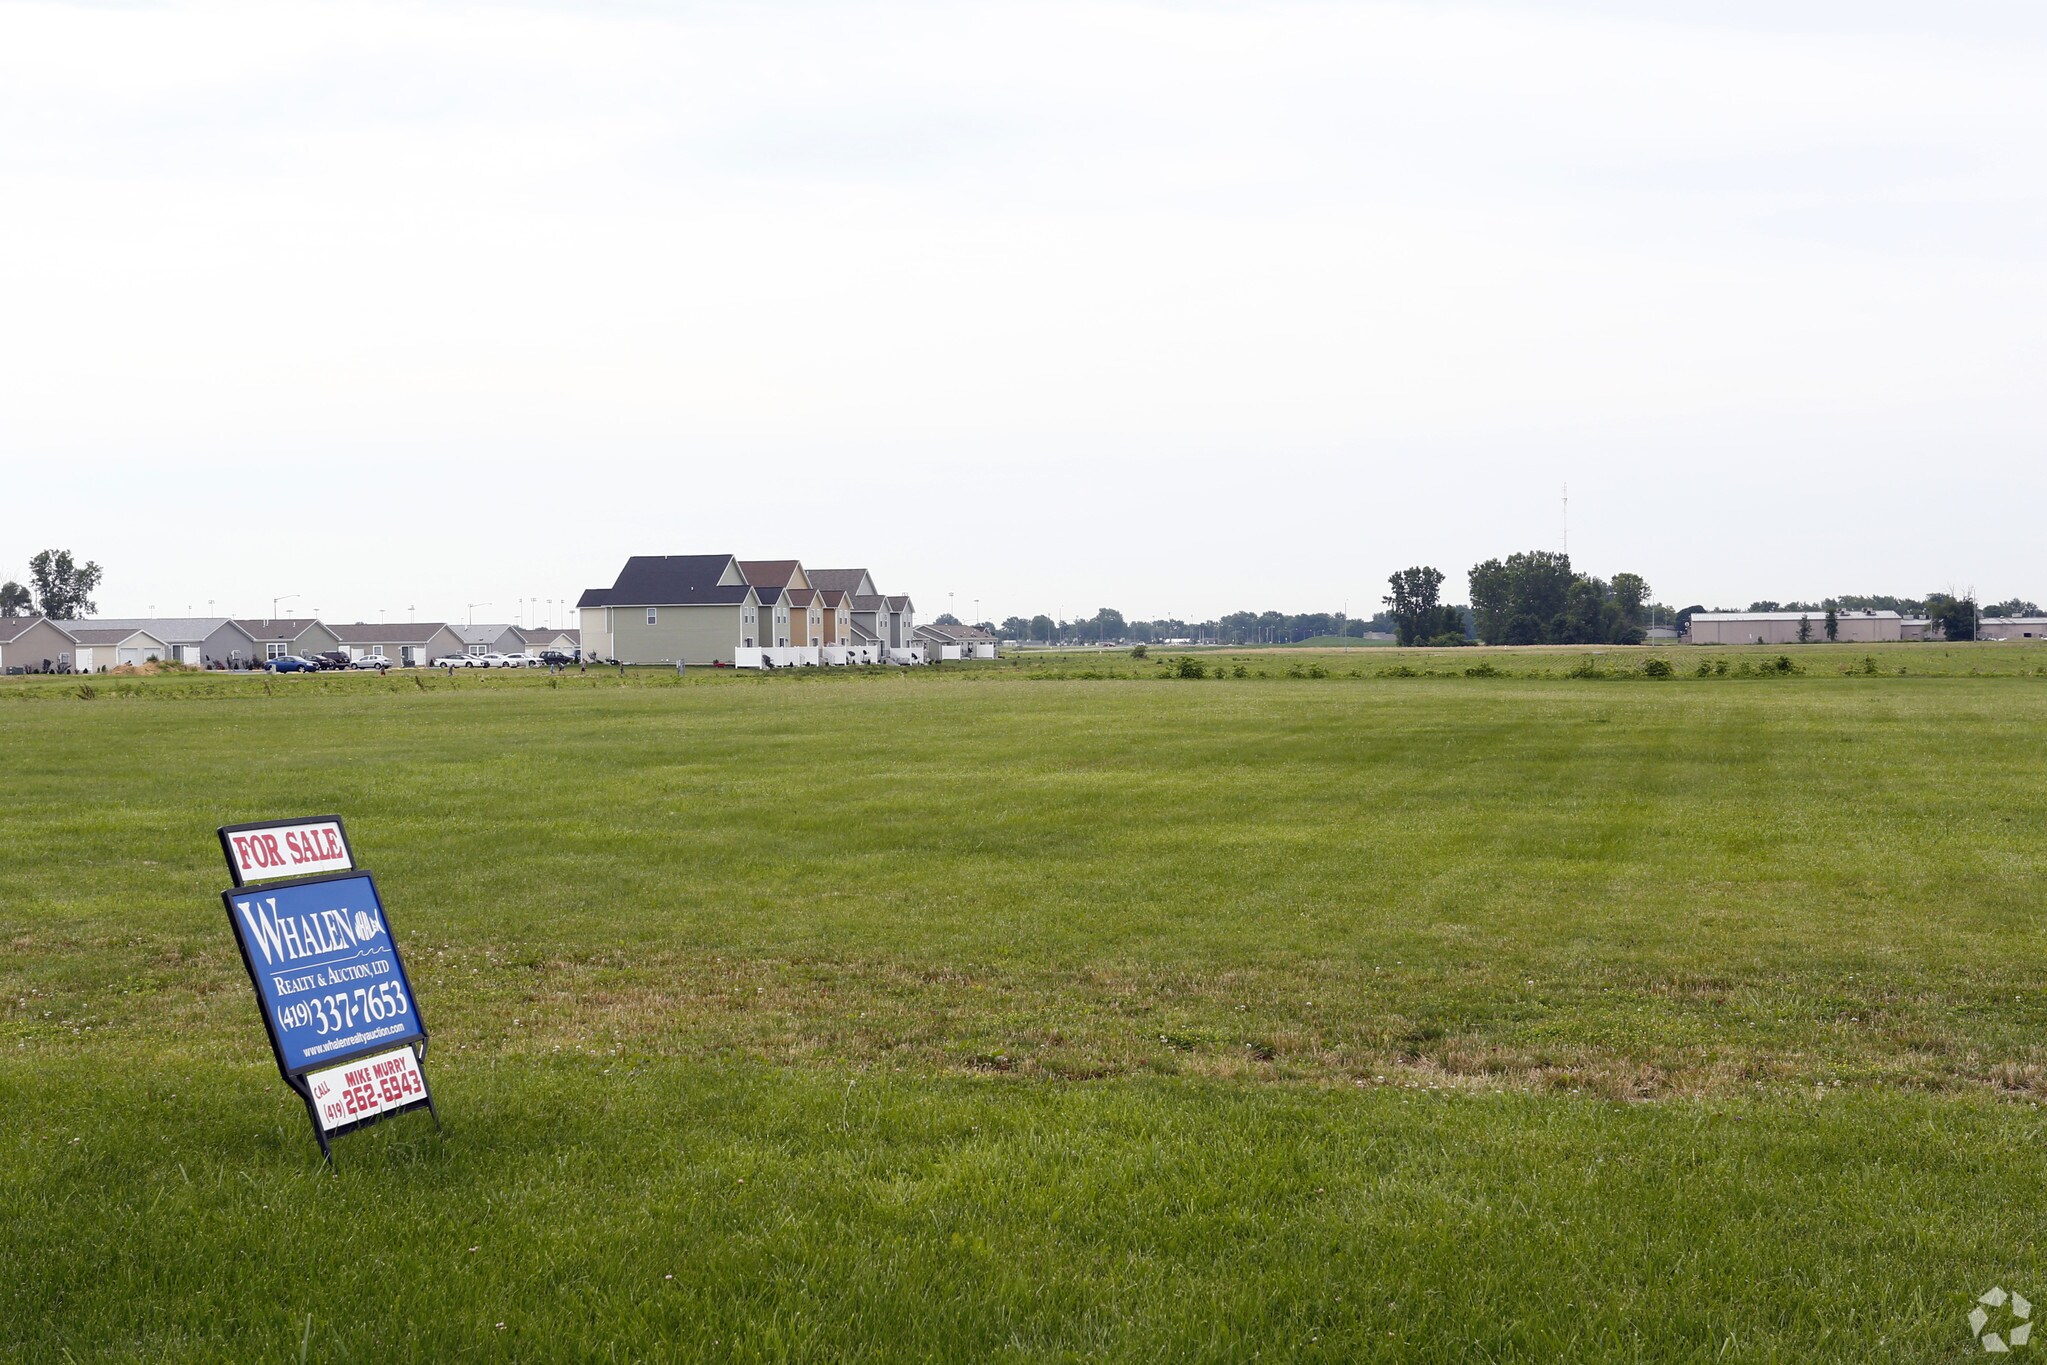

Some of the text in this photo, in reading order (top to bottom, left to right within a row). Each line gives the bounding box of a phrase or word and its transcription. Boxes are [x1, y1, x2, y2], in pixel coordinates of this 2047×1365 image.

[232, 828, 344, 870] FOR SALE
[237, 897, 358, 966] WHALEN
[272, 959, 390, 997] REALTY & AUCTION, LTD
[302, 1022, 405, 1058] www.whalenrealtyauction.com
[313, 1056, 407, 1100] CALL MIKE MURRY
[323, 1069, 422, 1123] (419) 262-6943
